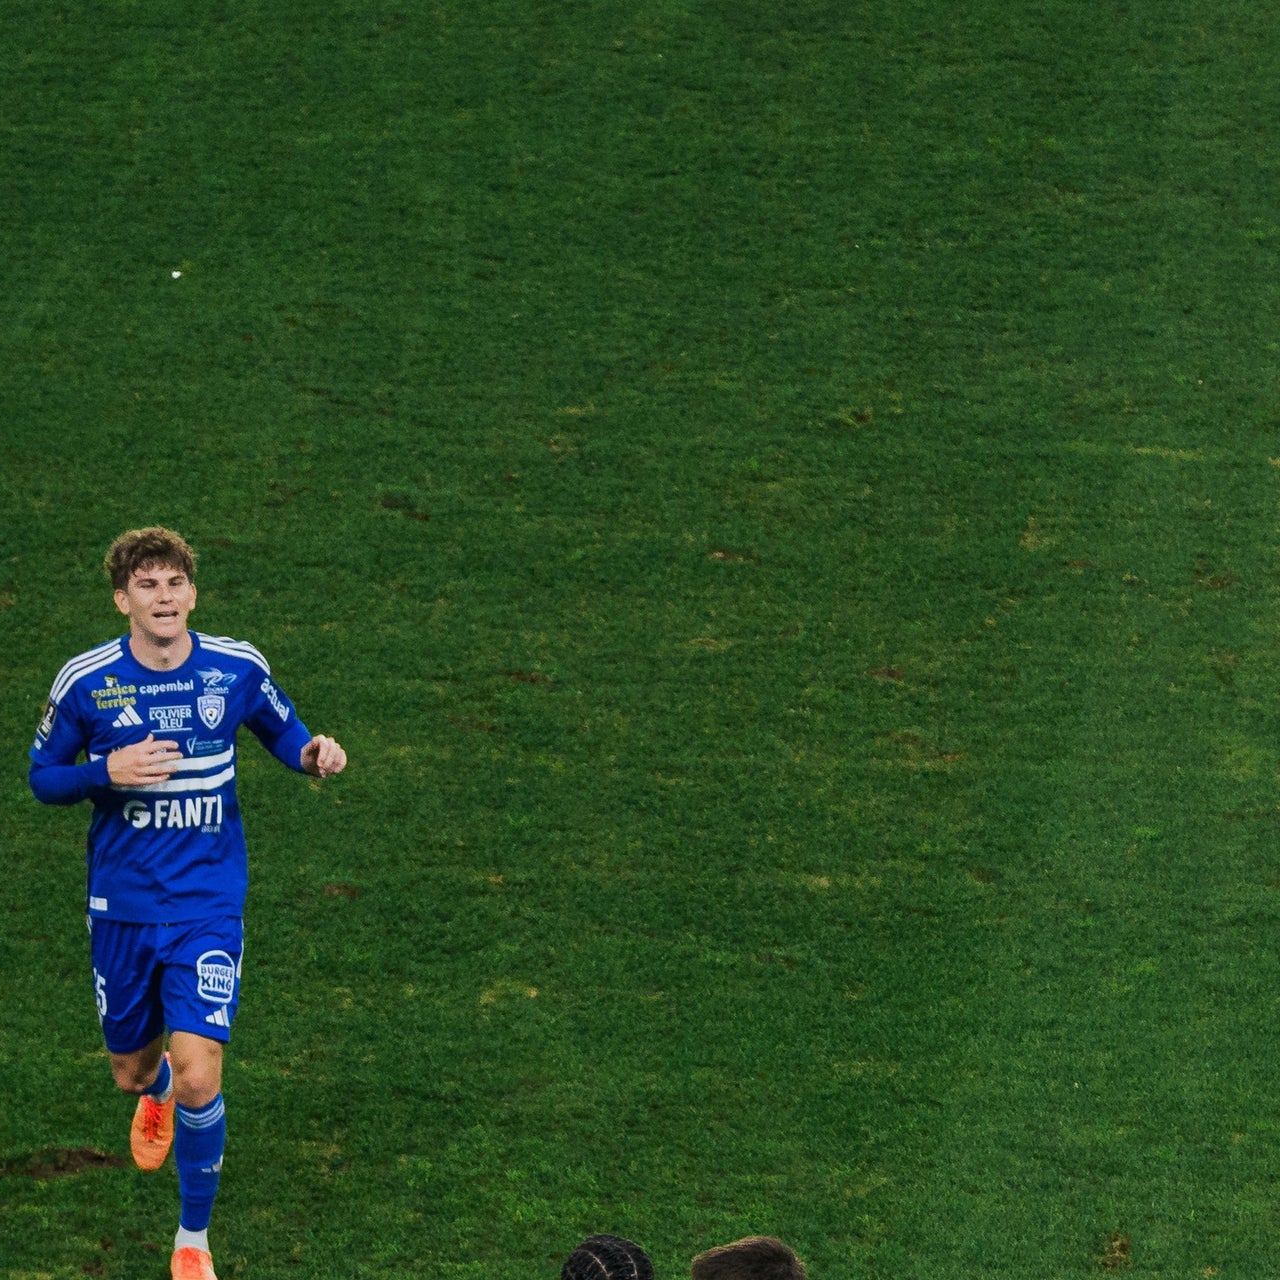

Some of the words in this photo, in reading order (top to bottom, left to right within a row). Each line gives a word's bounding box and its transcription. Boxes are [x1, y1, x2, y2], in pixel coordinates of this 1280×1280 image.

[139, 679, 194, 695] capembal
[260, 678, 289, 722] actual
[149, 708, 192, 721] L'OLIVIER
[160, 719, 183, 729] BLEU
[201, 976, 231, 991] KING
